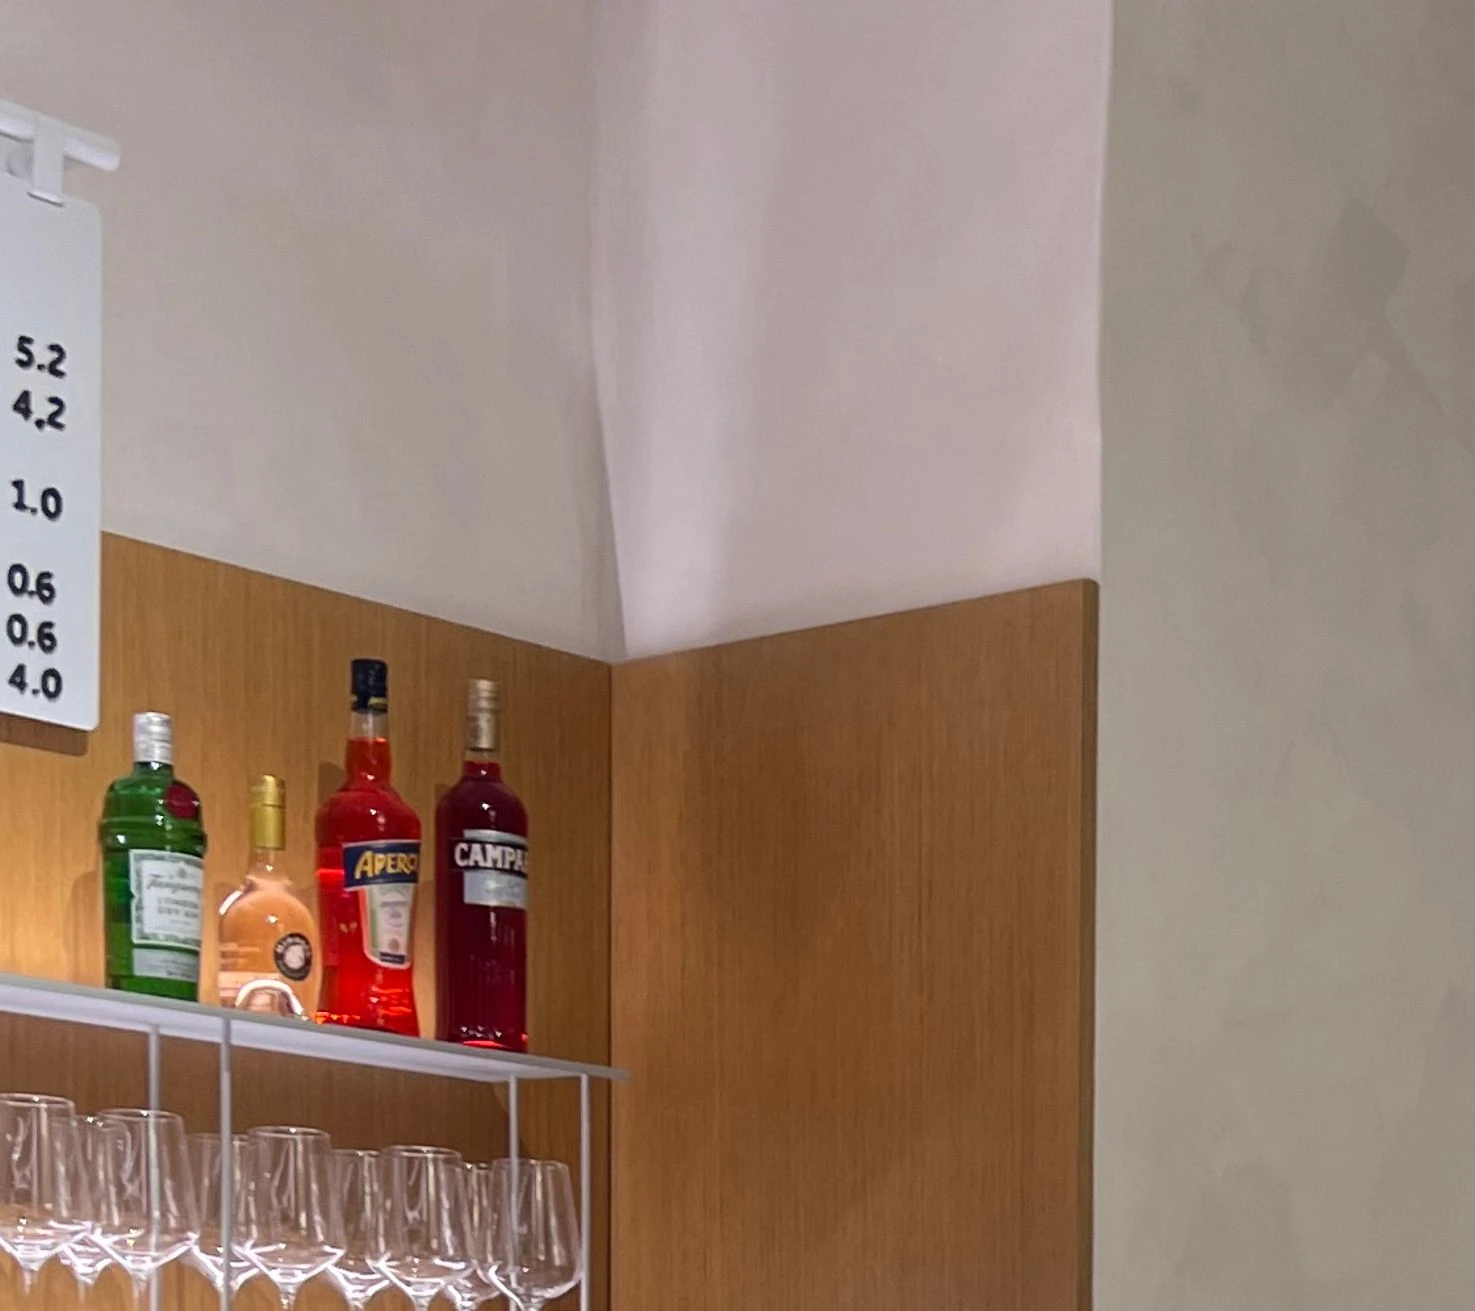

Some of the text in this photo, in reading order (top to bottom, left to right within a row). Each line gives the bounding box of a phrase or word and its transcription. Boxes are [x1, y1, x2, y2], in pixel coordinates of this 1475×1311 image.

[15, 335, 67, 379] 5.2
[11, 479, 63, 521] 1.0
[6, 563, 57, 605] 0.6
[6, 613, 57, 654] 0.6
[8, 663, 63, 701] 4.0
[354, 850, 419, 879] APERO
[454, 842, 528, 873] CAMPA
